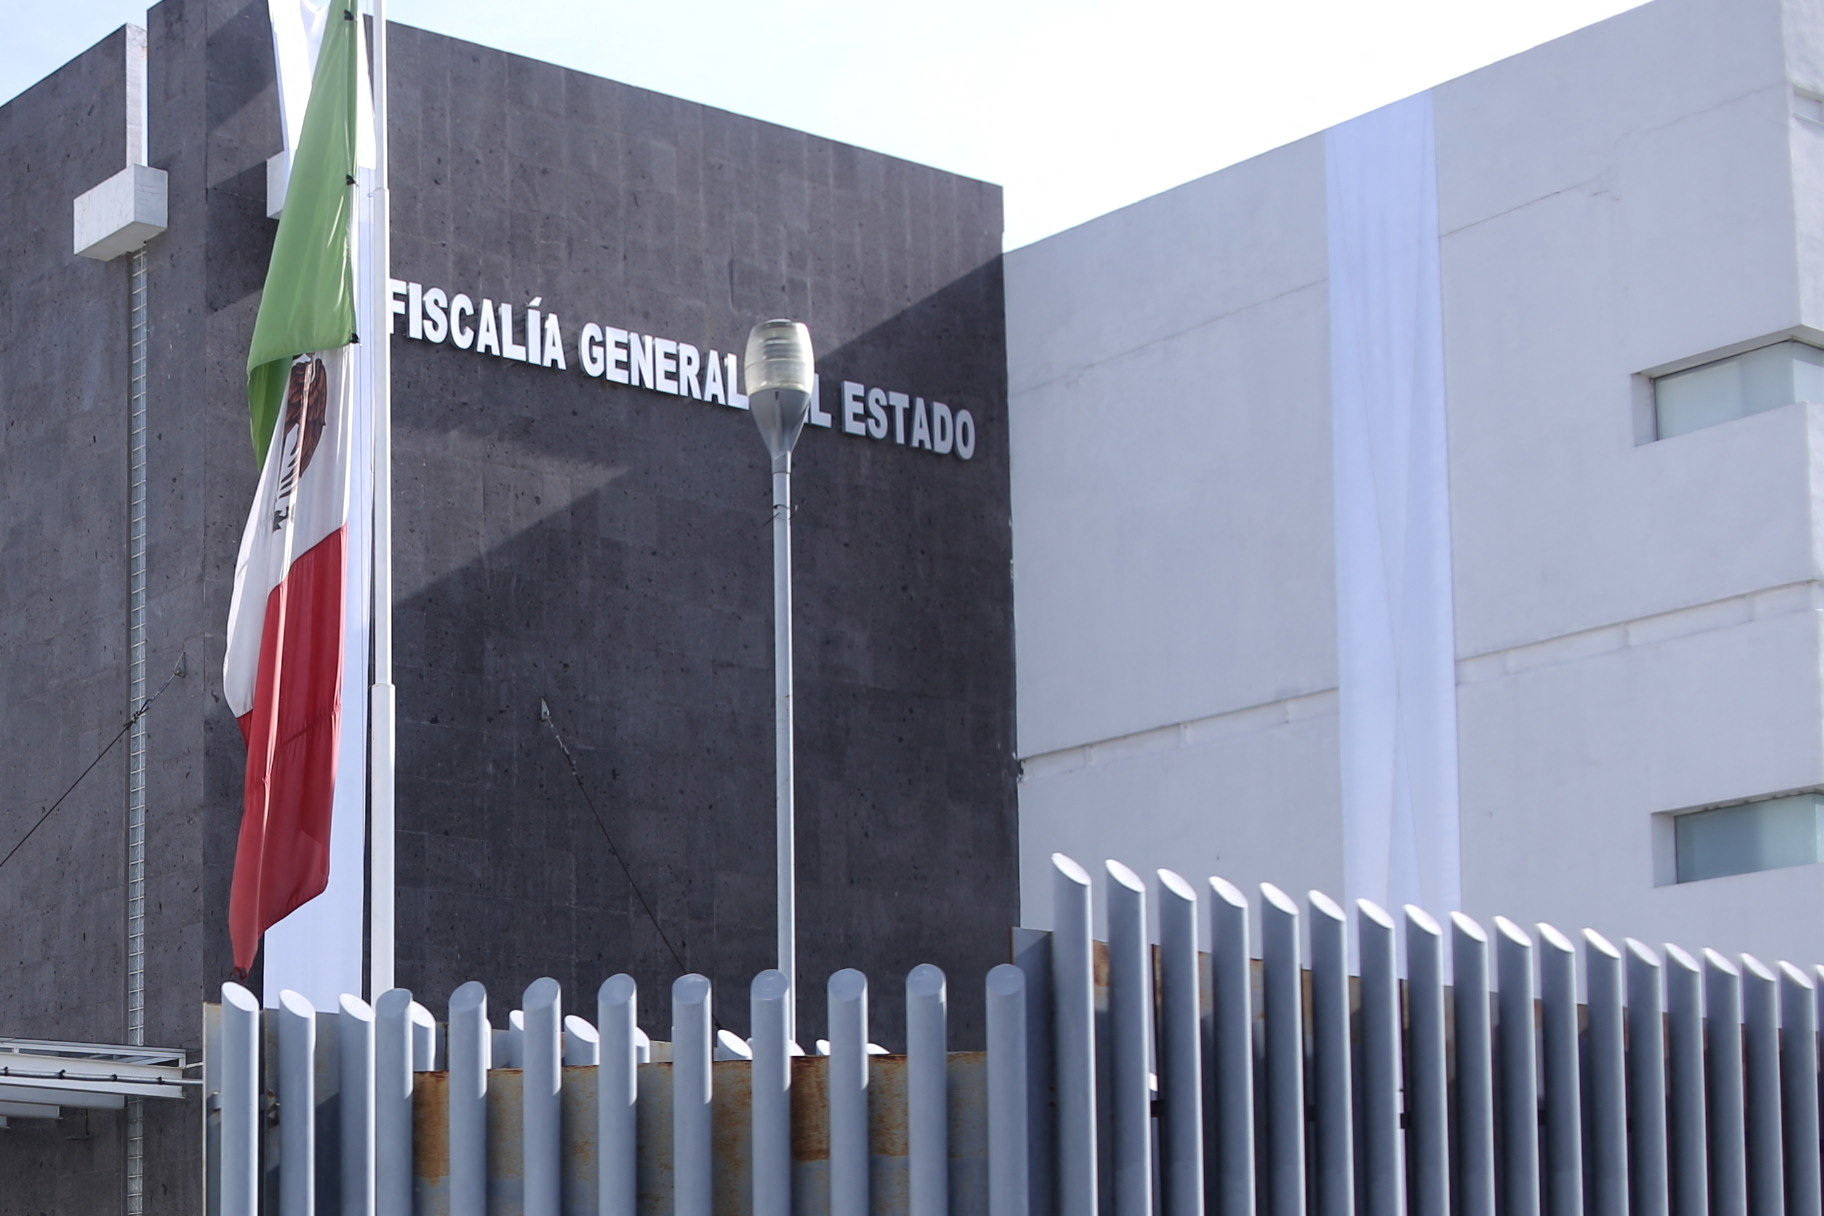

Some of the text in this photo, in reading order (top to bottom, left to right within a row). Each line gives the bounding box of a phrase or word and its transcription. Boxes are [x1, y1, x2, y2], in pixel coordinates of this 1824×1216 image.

[390, 278, 567, 371] FISCALÍA
[581, 322, 750, 411] GENERAL
[841, 380, 976, 461] ESTADO
